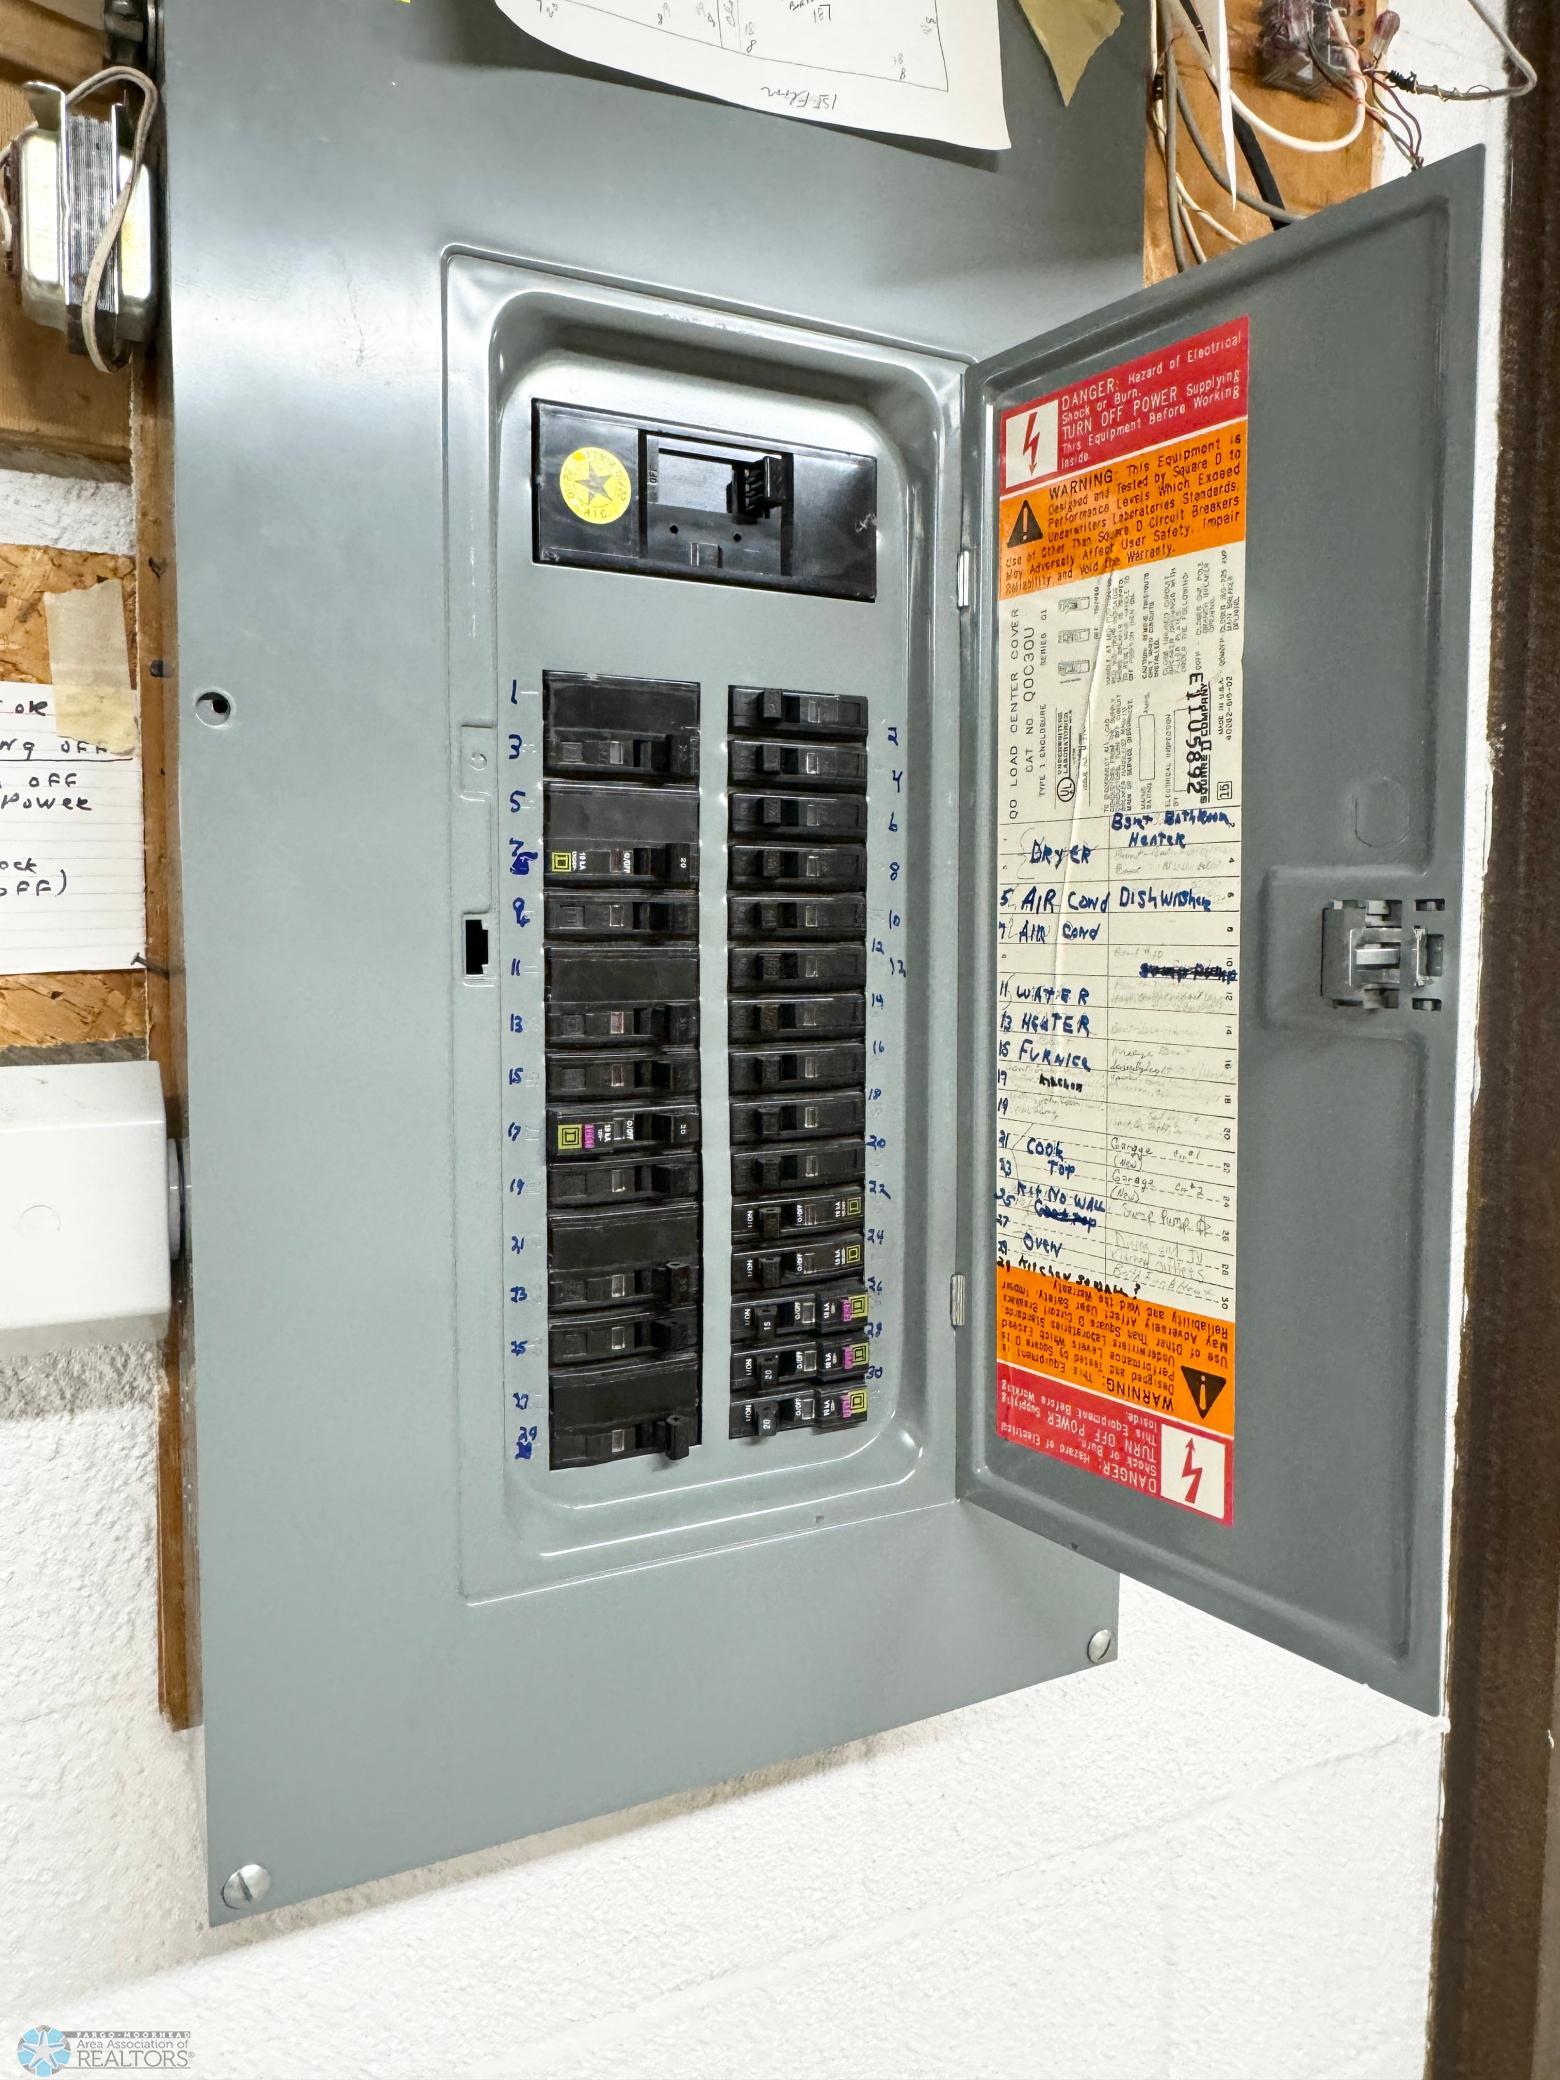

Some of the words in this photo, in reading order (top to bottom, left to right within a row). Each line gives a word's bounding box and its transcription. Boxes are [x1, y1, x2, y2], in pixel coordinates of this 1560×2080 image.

[1062, 378, 1119, 411] DANGER:
[1129, 362, 1163, 384] Hazard
[1170, 354, 1180, 370] of
[1188, 331, 1241, 363] Electrical
[1062, 417, 1091, 440] TURN
[1102, 405, 1123, 427] OFF
[1133, 386, 1177, 415] POWER
[1187, 370, 1239, 396] Supplying
[1062, 404, 1090, 424] Shock
[1097, 401, 1107, 411] or
[1115, 388, 1141, 405] Burn.
[1062, 441, 1081, 453] This
[1089, 417, 1141, 446] Equipment
[1149, 404, 1185, 424] Before
[1193, 385, 1239, 408] Working
[1127, 462, 1149, 476] This
[1158, 438, 1220, 467] Equipment
[1048, 495, 1088, 515] Designed
[1117, 475, 1148, 493] Tested
[1174, 459, 1208, 478] Square
[1048, 504, 1109, 528] Performance
[1117, 491, 1150, 510] Levels
[1159, 479, 1190, 496] Which
[1199, 463, 1240, 485] Exceed
[1098, 526, 1129, 542] Square
[1149, 509, 1184, 528] Circuit
[1192, 496, 1239, 518] Breakers
[1113, 498, 1175, 524] Laboratories
[1030, 556, 1074, 574] Adversely
[1083, 543, 1114, 561] Affect
[1121, 535, 1146, 550] User
[1203, 511, 1240, 528] Impair
[1057, 568, 1073, 581] and
[1080, 560, 1098, 574] Void
[1104, 555, 1120, 568] the
[1011, 608, 1019, 660] COVER
[1010, 672, 1018, 733] CENTER
[1201, 683, 1209, 737] COMPANY
[509, 734, 522, 760] 3
[1009, 746, 1018, 787] LOAD
[29, 772, 78, 788] OFF
[892, 769, 903, 793] 4
[510, 790, 526, 813] 5
[1009, 799, 1018, 819] QO
[888, 812, 898, 832] 6
[889, 861, 900, 881] 8
[1020, 886, 1056, 914] AIR
[889, 909, 901, 929] 10
[1019, 919, 1046, 943] AIR
[872, 938, 885, 955] 12
[510, 958, 521, 977] 11
[872, 993, 884, 1010] 14
[1016, 985, 1090, 1005] WATER
[510, 1013, 523, 1033] 13
[873, 1040, 885, 1055] 16
[509, 1067, 524, 1085] 15
[868, 1088, 882, 1101] 18
[507, 1121, 521, 1142] 17
[866, 1135, 886, 1151] 20
[1111, 1137, 1152, 1160] Garage
[510, 1178, 525, 1196] 19
[1112, 1168, 1154, 1192] Garage
[763, 1321, 771, 1331] 15
[1145, 1318, 1197, 1344] Adversely
[1172, 1311, 1228, 1339] Reliability
[1156, 1338, 1182, 1355] Other
[1206, 1336, 1228, 1353] May
[1207, 1353, 1228, 1368] Use
[866, 1366, 883, 1380] 30
[1102, 1376, 1173, 1412] WARNING:
[1041, 1396, 1071, 1416] Before
[763, 1419, 771, 1430] 20
[1048, 1411, 1085, 1436] POWER
[1077, 1408, 1128, 1437] Equipment
[1095, 1429, 1116, 1447] OFF
[1136, 1429, 1157, 1446] This
[1060, 1444, 1090, 1464] Hazard
[1125, 1439, 1157, 1463] TURN
[1099, 1458, 1157, 1493] DANGER:
[1126, 1456, 1157, 1477] Shock
